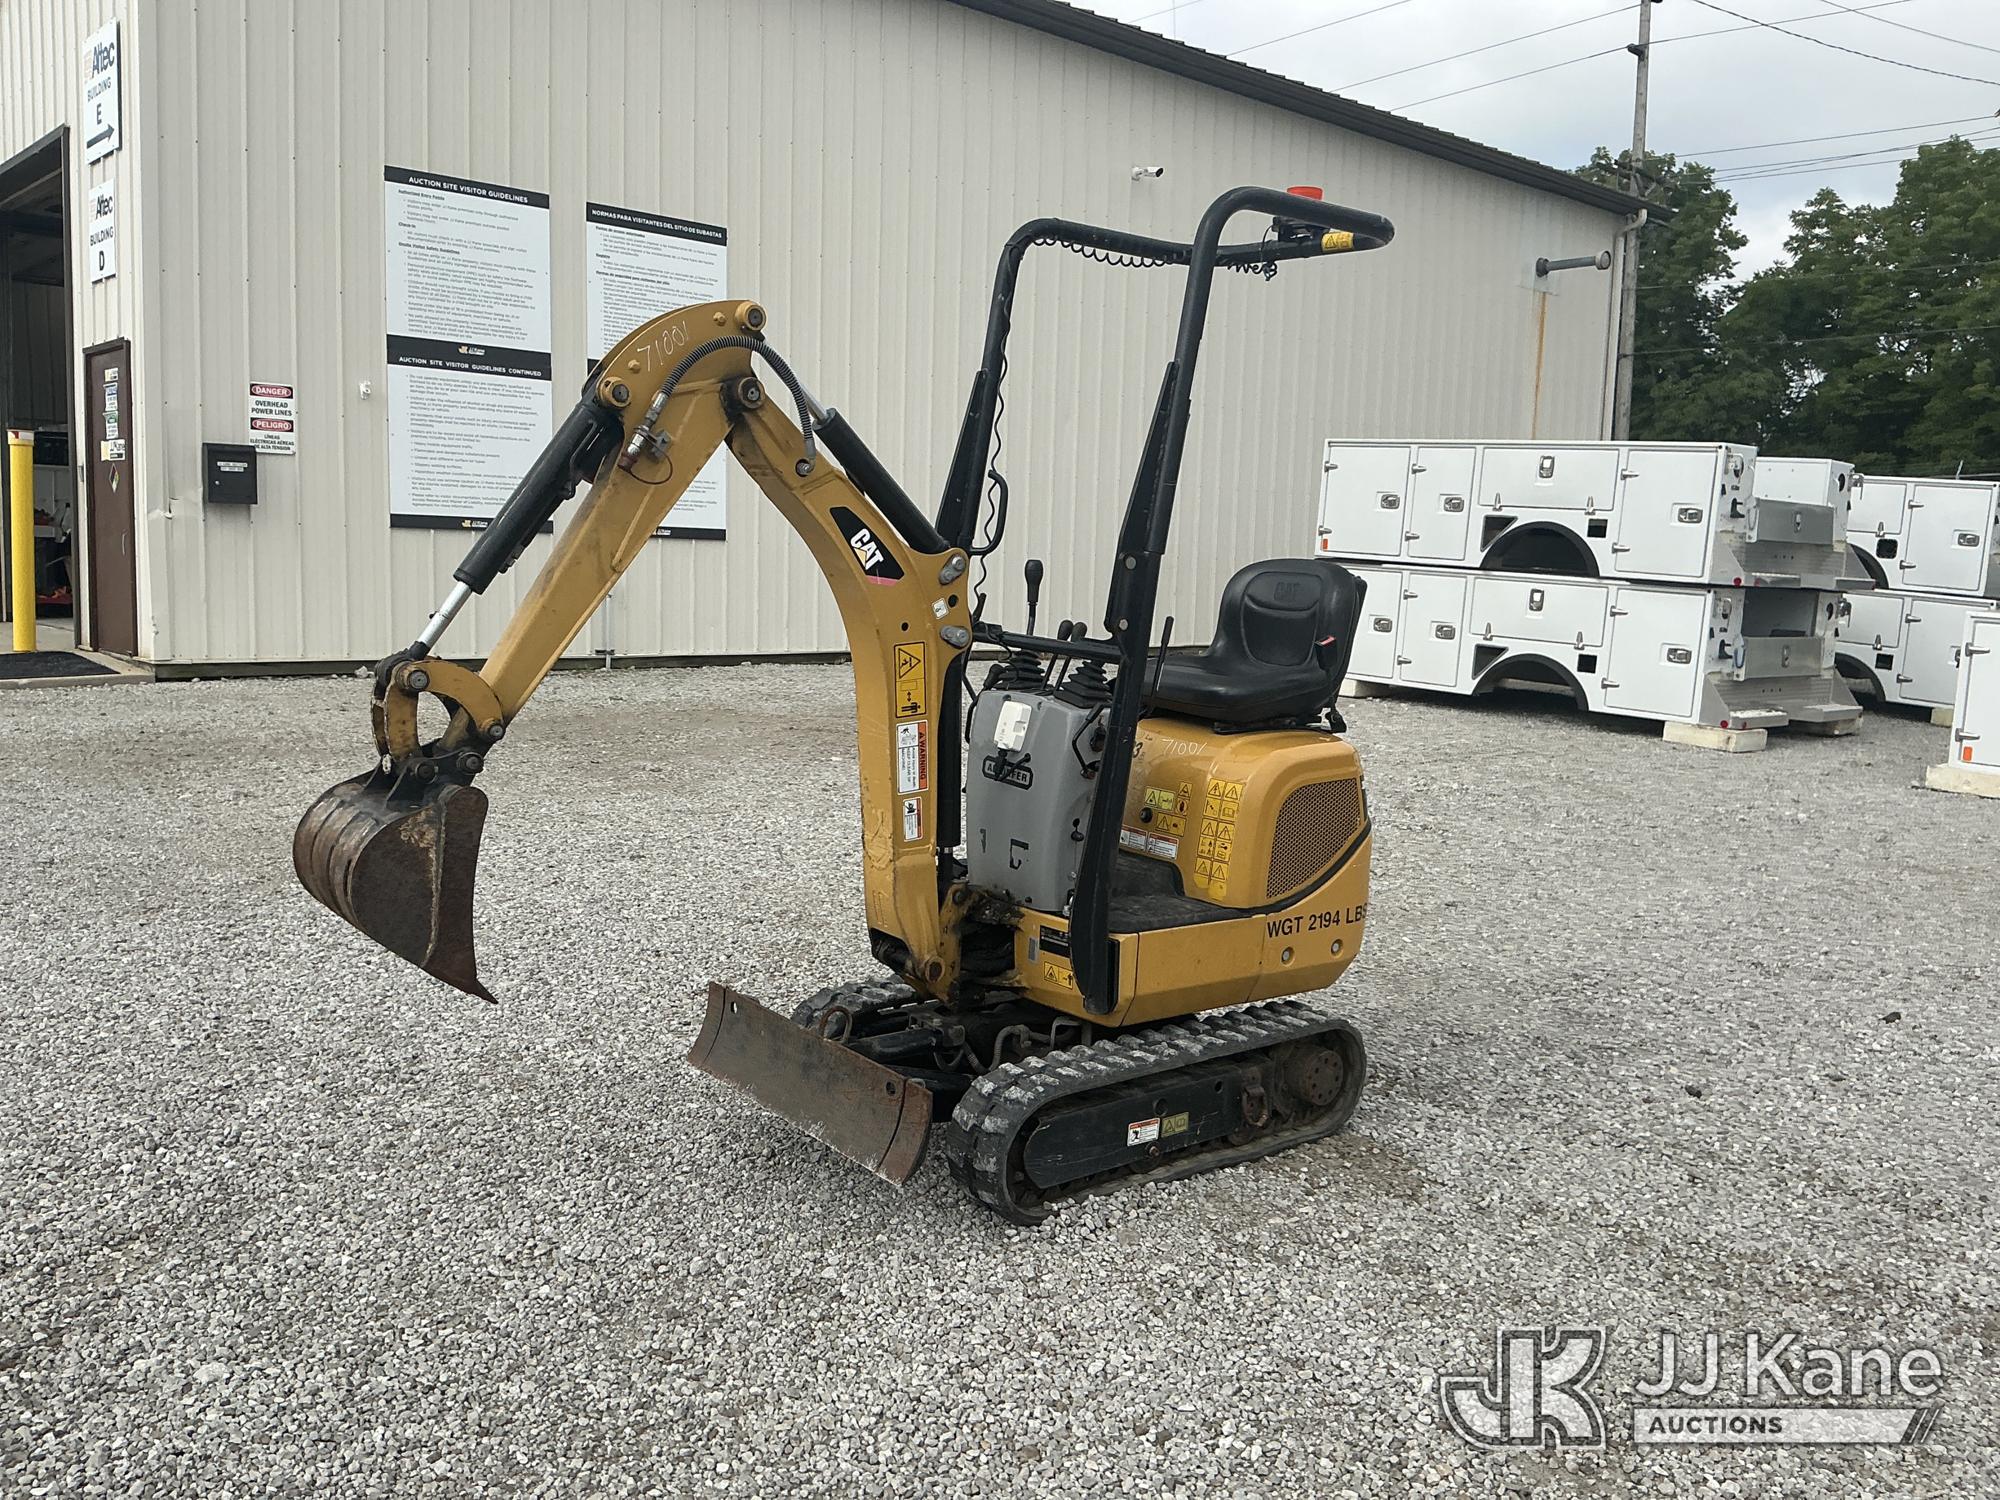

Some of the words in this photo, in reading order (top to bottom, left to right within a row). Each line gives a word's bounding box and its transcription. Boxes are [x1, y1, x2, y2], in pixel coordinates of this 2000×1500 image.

[92, 42, 115, 78] Altec
[87, 77, 112, 102] BUILDING
[96, 103, 102, 125] E
[409, 177, 441, 188] AUCTION
[443, 182, 458, 191] SITE
[460, 185, 487, 195] VISITOR
[488, 190, 529, 203] GUIDELINES
[95, 193, 113, 220] Altec
[90, 226, 114, 246] BUILDING
[592, 209, 616, 219] NORMAS
[632, 217, 663, 227] VISITANTES
[696, 229, 722, 238] SUBASTAS
[99, 250, 105, 271] D
[637, 320, 688, 371] 71001
[399, 356, 427, 364] AUCTION
[446, 361, 469, 369] VISITOR
[472, 364, 506, 373] GUIDELINES
[508, 368, 542, 377] CONTINUED
[256, 387, 287, 395] DANGER
[255, 400, 288, 408] OVERHEAD
[257, 421, 288, 429] PELIGRO
[850, 528, 884, 570] CAT
[1267, 916, 1304, 937] WGT
[1308, 910, 1341, 931] 2194
